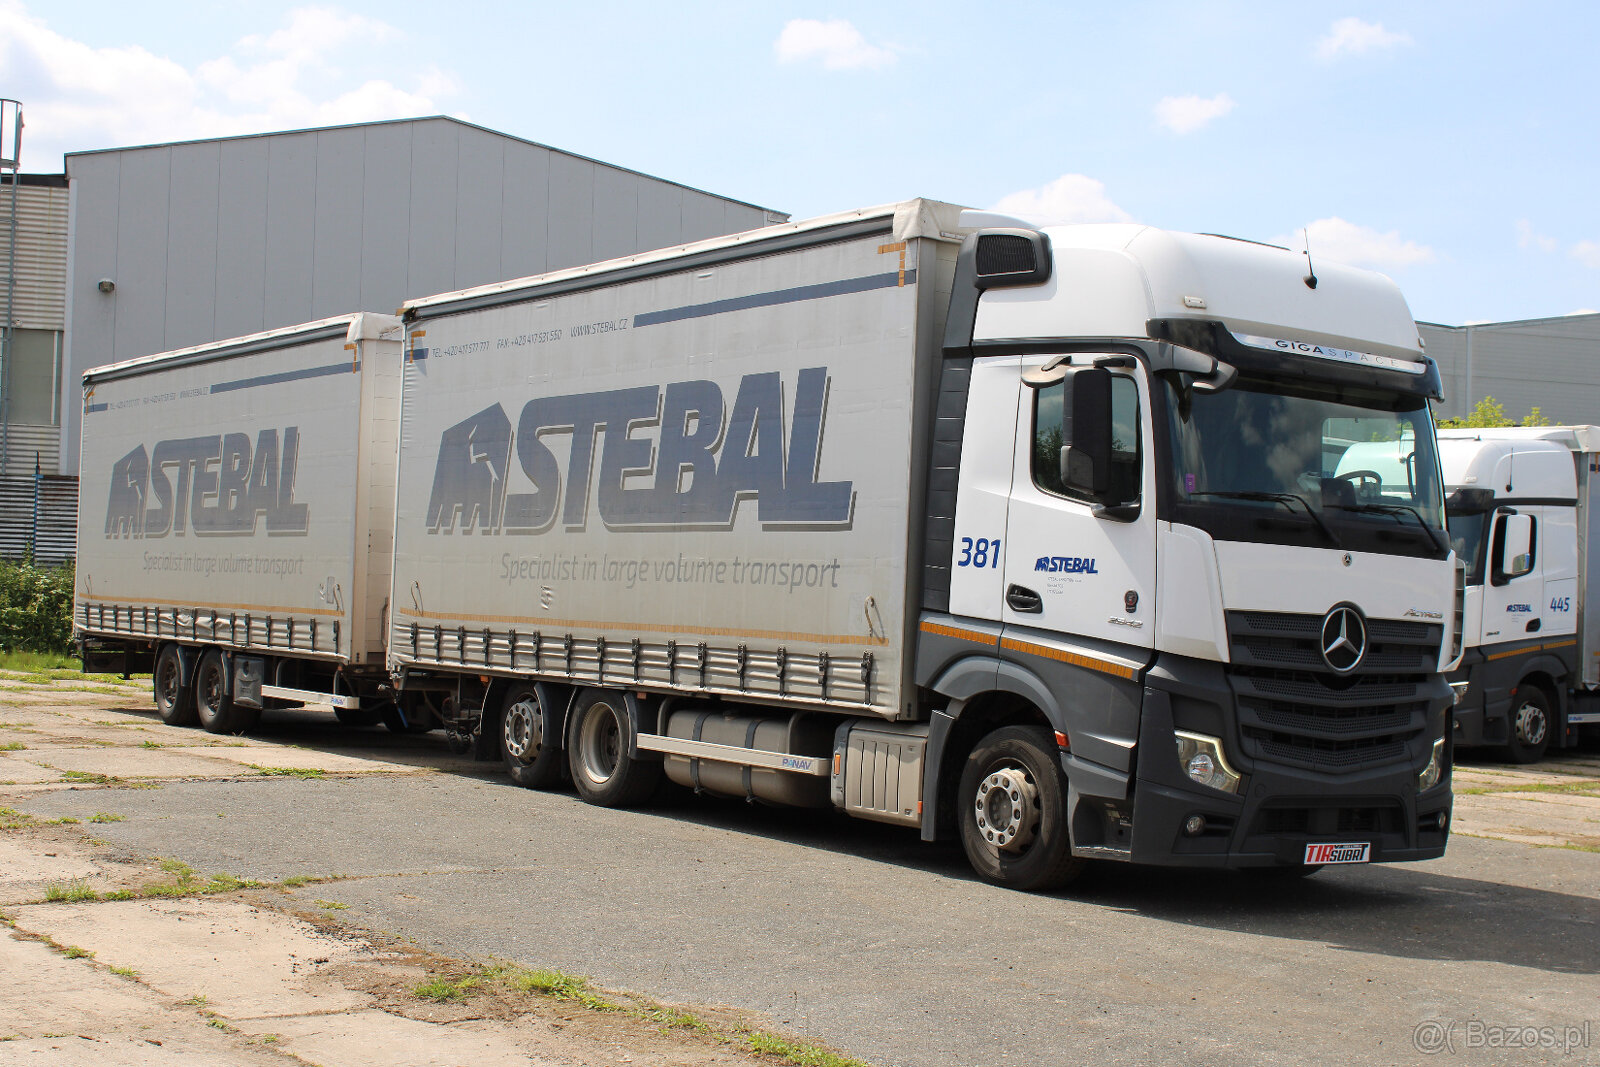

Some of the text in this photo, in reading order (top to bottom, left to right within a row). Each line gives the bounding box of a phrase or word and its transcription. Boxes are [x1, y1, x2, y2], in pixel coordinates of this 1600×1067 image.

[143, 551, 304, 580] Specialist in large volume transport
[958, 536, 1001, 569] 381
[500, 552, 841, 594] Specialist in large volume transport
[1549, 596, 1570, 612] 445
[1306, 844, 1334, 863] TIR
